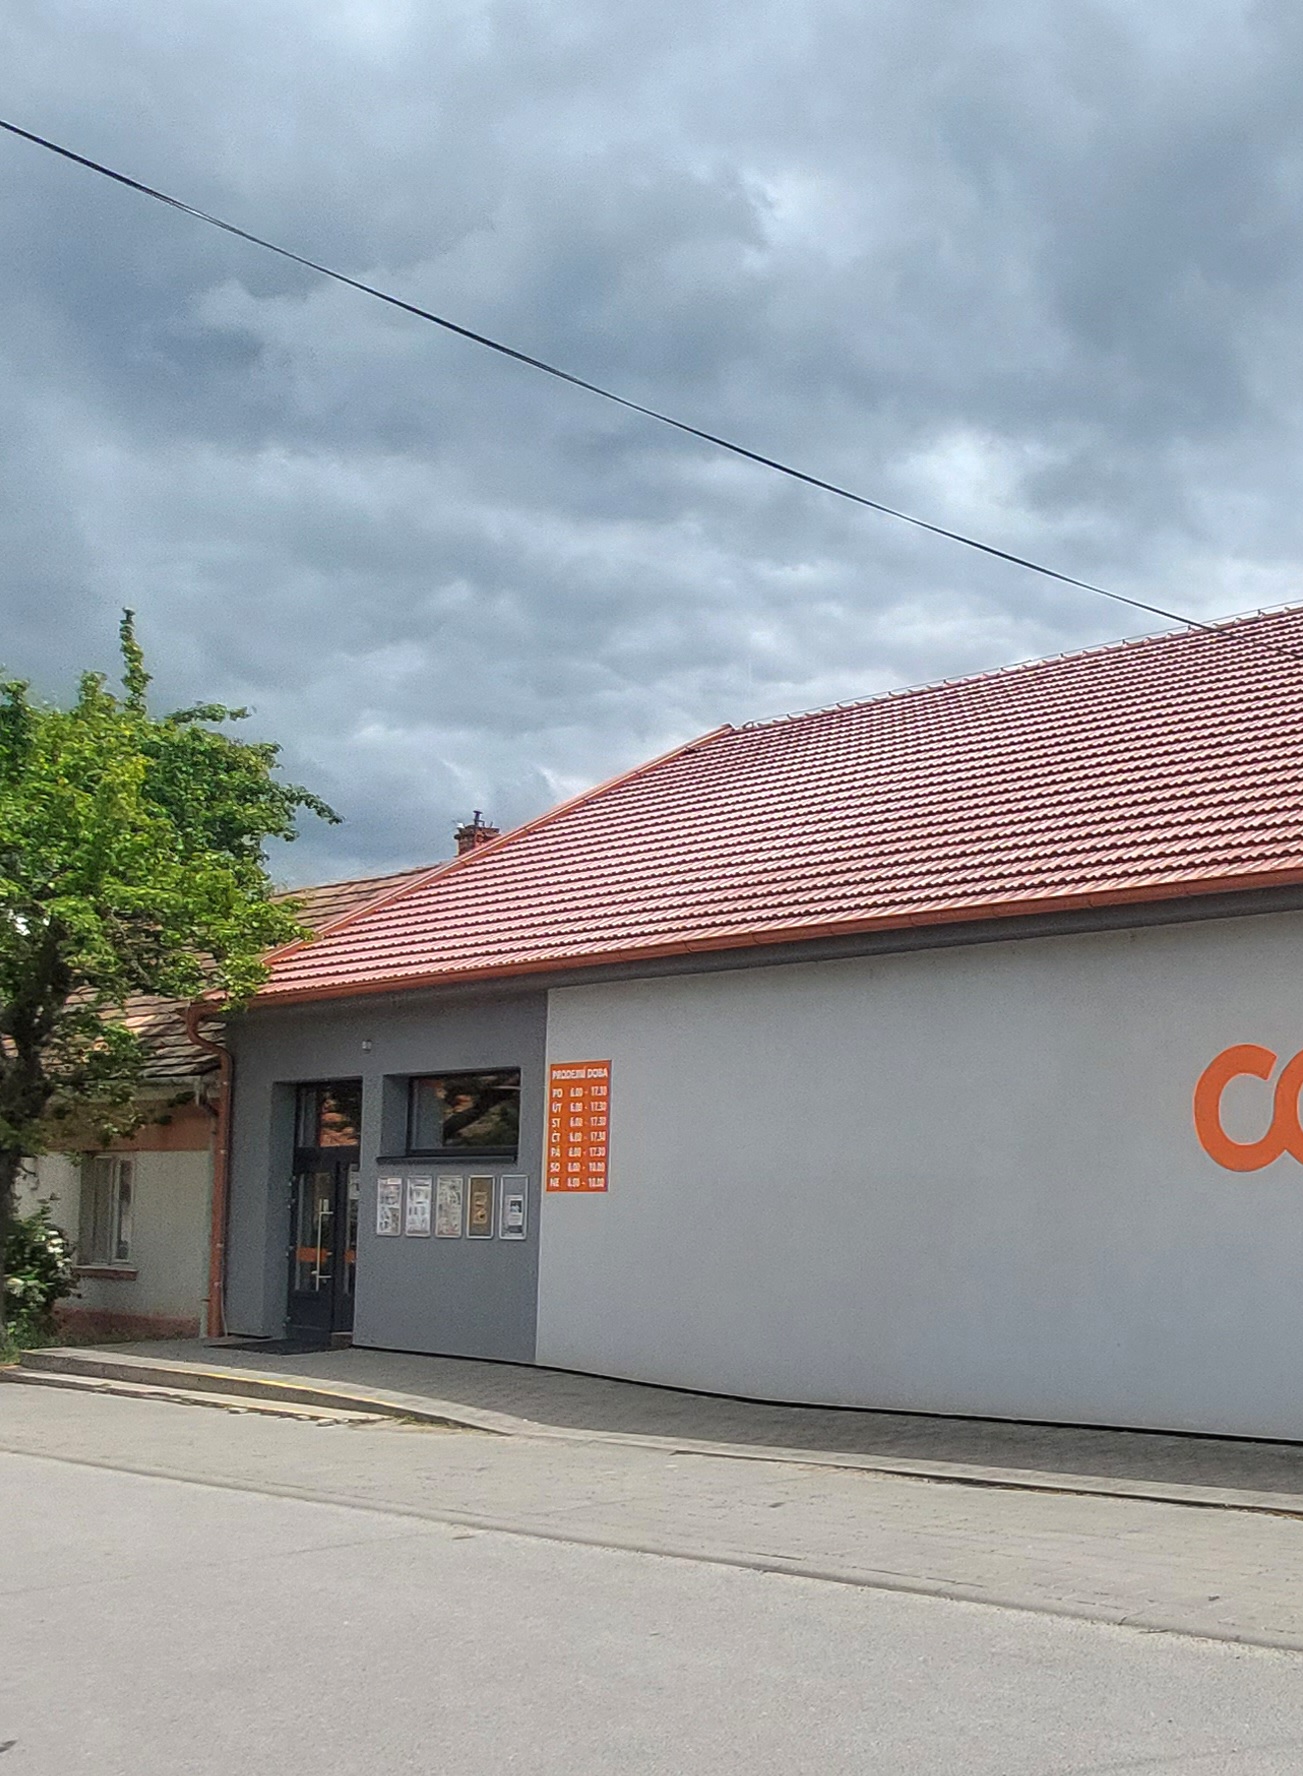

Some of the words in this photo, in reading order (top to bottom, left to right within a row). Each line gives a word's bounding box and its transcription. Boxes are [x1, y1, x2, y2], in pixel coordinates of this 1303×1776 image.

[587, 1067, 608, 1079] DOBA
[552, 1088, 563, 1098] PO
[552, 1101, 562, 1113] ÚT
[551, 1118, 561, 1129] ST
[551, 1130, 561, 1143] ČT
[550, 1145, 561, 1157] PÁ
[550, 1162, 560, 1172] SO
[549, 1177, 560, 1187] NE
